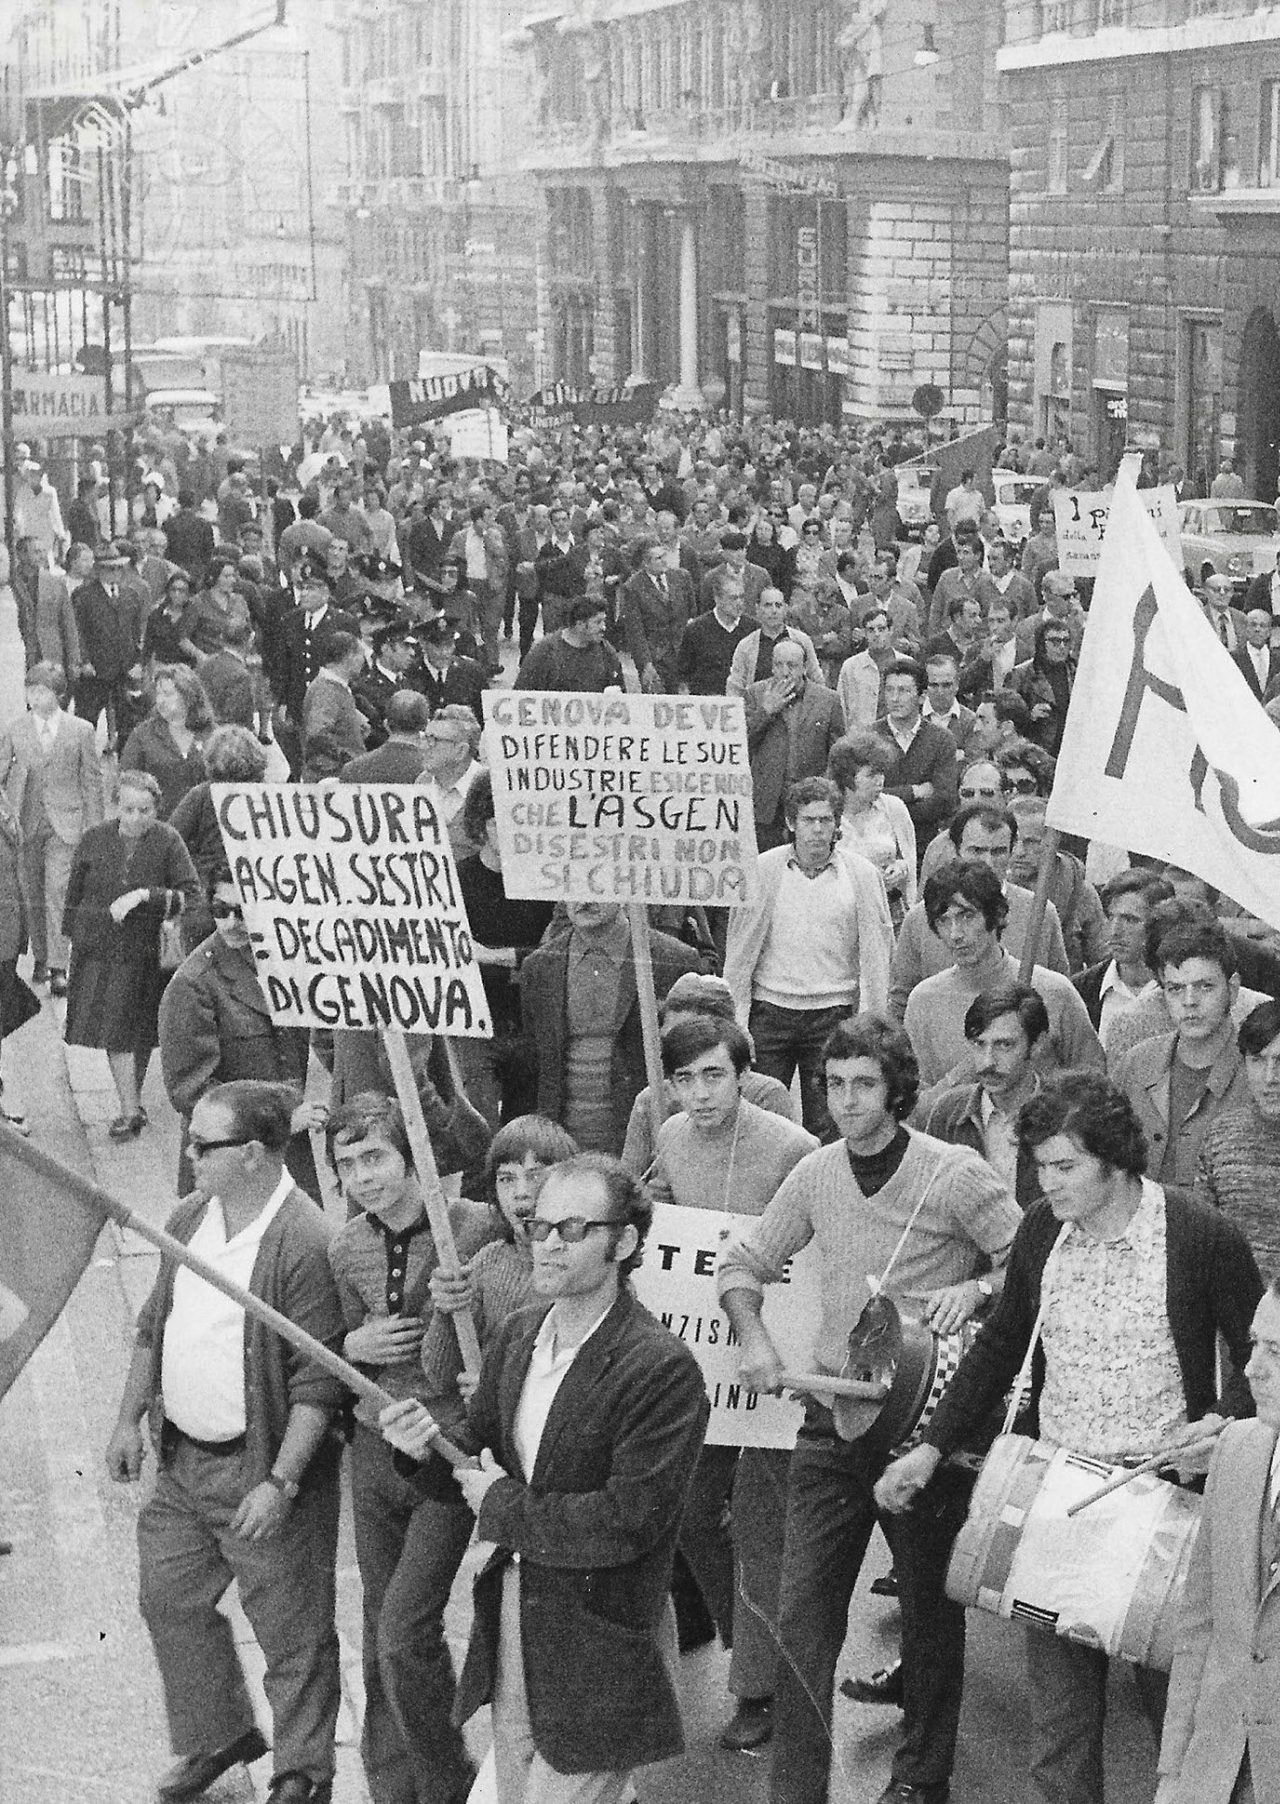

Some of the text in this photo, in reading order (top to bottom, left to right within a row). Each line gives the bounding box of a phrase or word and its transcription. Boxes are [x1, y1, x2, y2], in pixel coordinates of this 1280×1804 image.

[8, 389, 98, 416] ARMACIA
[492, 697, 738, 733] GENOVA DEVE
[501, 733, 742, 765] DIFENDERE LE SUE
[507, 766, 642, 793] INDUSTRIE
[220, 791, 441, 846] CHIUSURA
[511, 794, 740, 833] CHE L'ASGEN
[675, 838, 741, 864] NON
[350, 850, 457, 912] SESTRI
[541, 863, 746, 902] SI CHIUDA
[273, 916, 473, 970] DECADIMENTO
[267, 974, 303, 1014] DI
